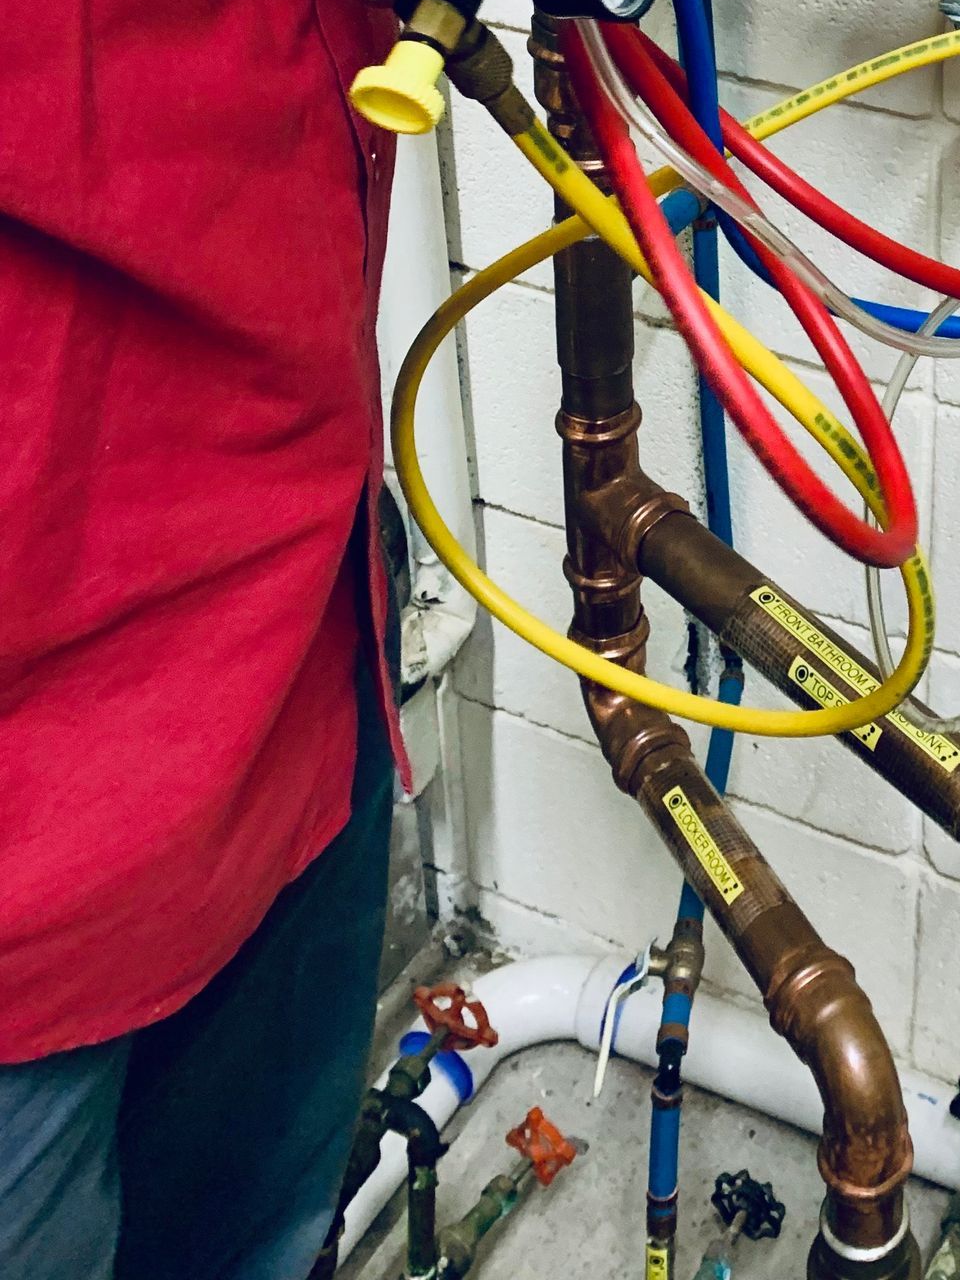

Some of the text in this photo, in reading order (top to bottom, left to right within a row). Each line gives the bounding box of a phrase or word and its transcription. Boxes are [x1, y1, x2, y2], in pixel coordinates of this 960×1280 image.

[773, 602, 810, 634] FRONT
[806, 632, 869, 686] BATHROOM
[915, 730, 948, 755] SINK
[809, 678, 835, 703] TOP
[678, 808, 731, 885] LOCKER ROOM
